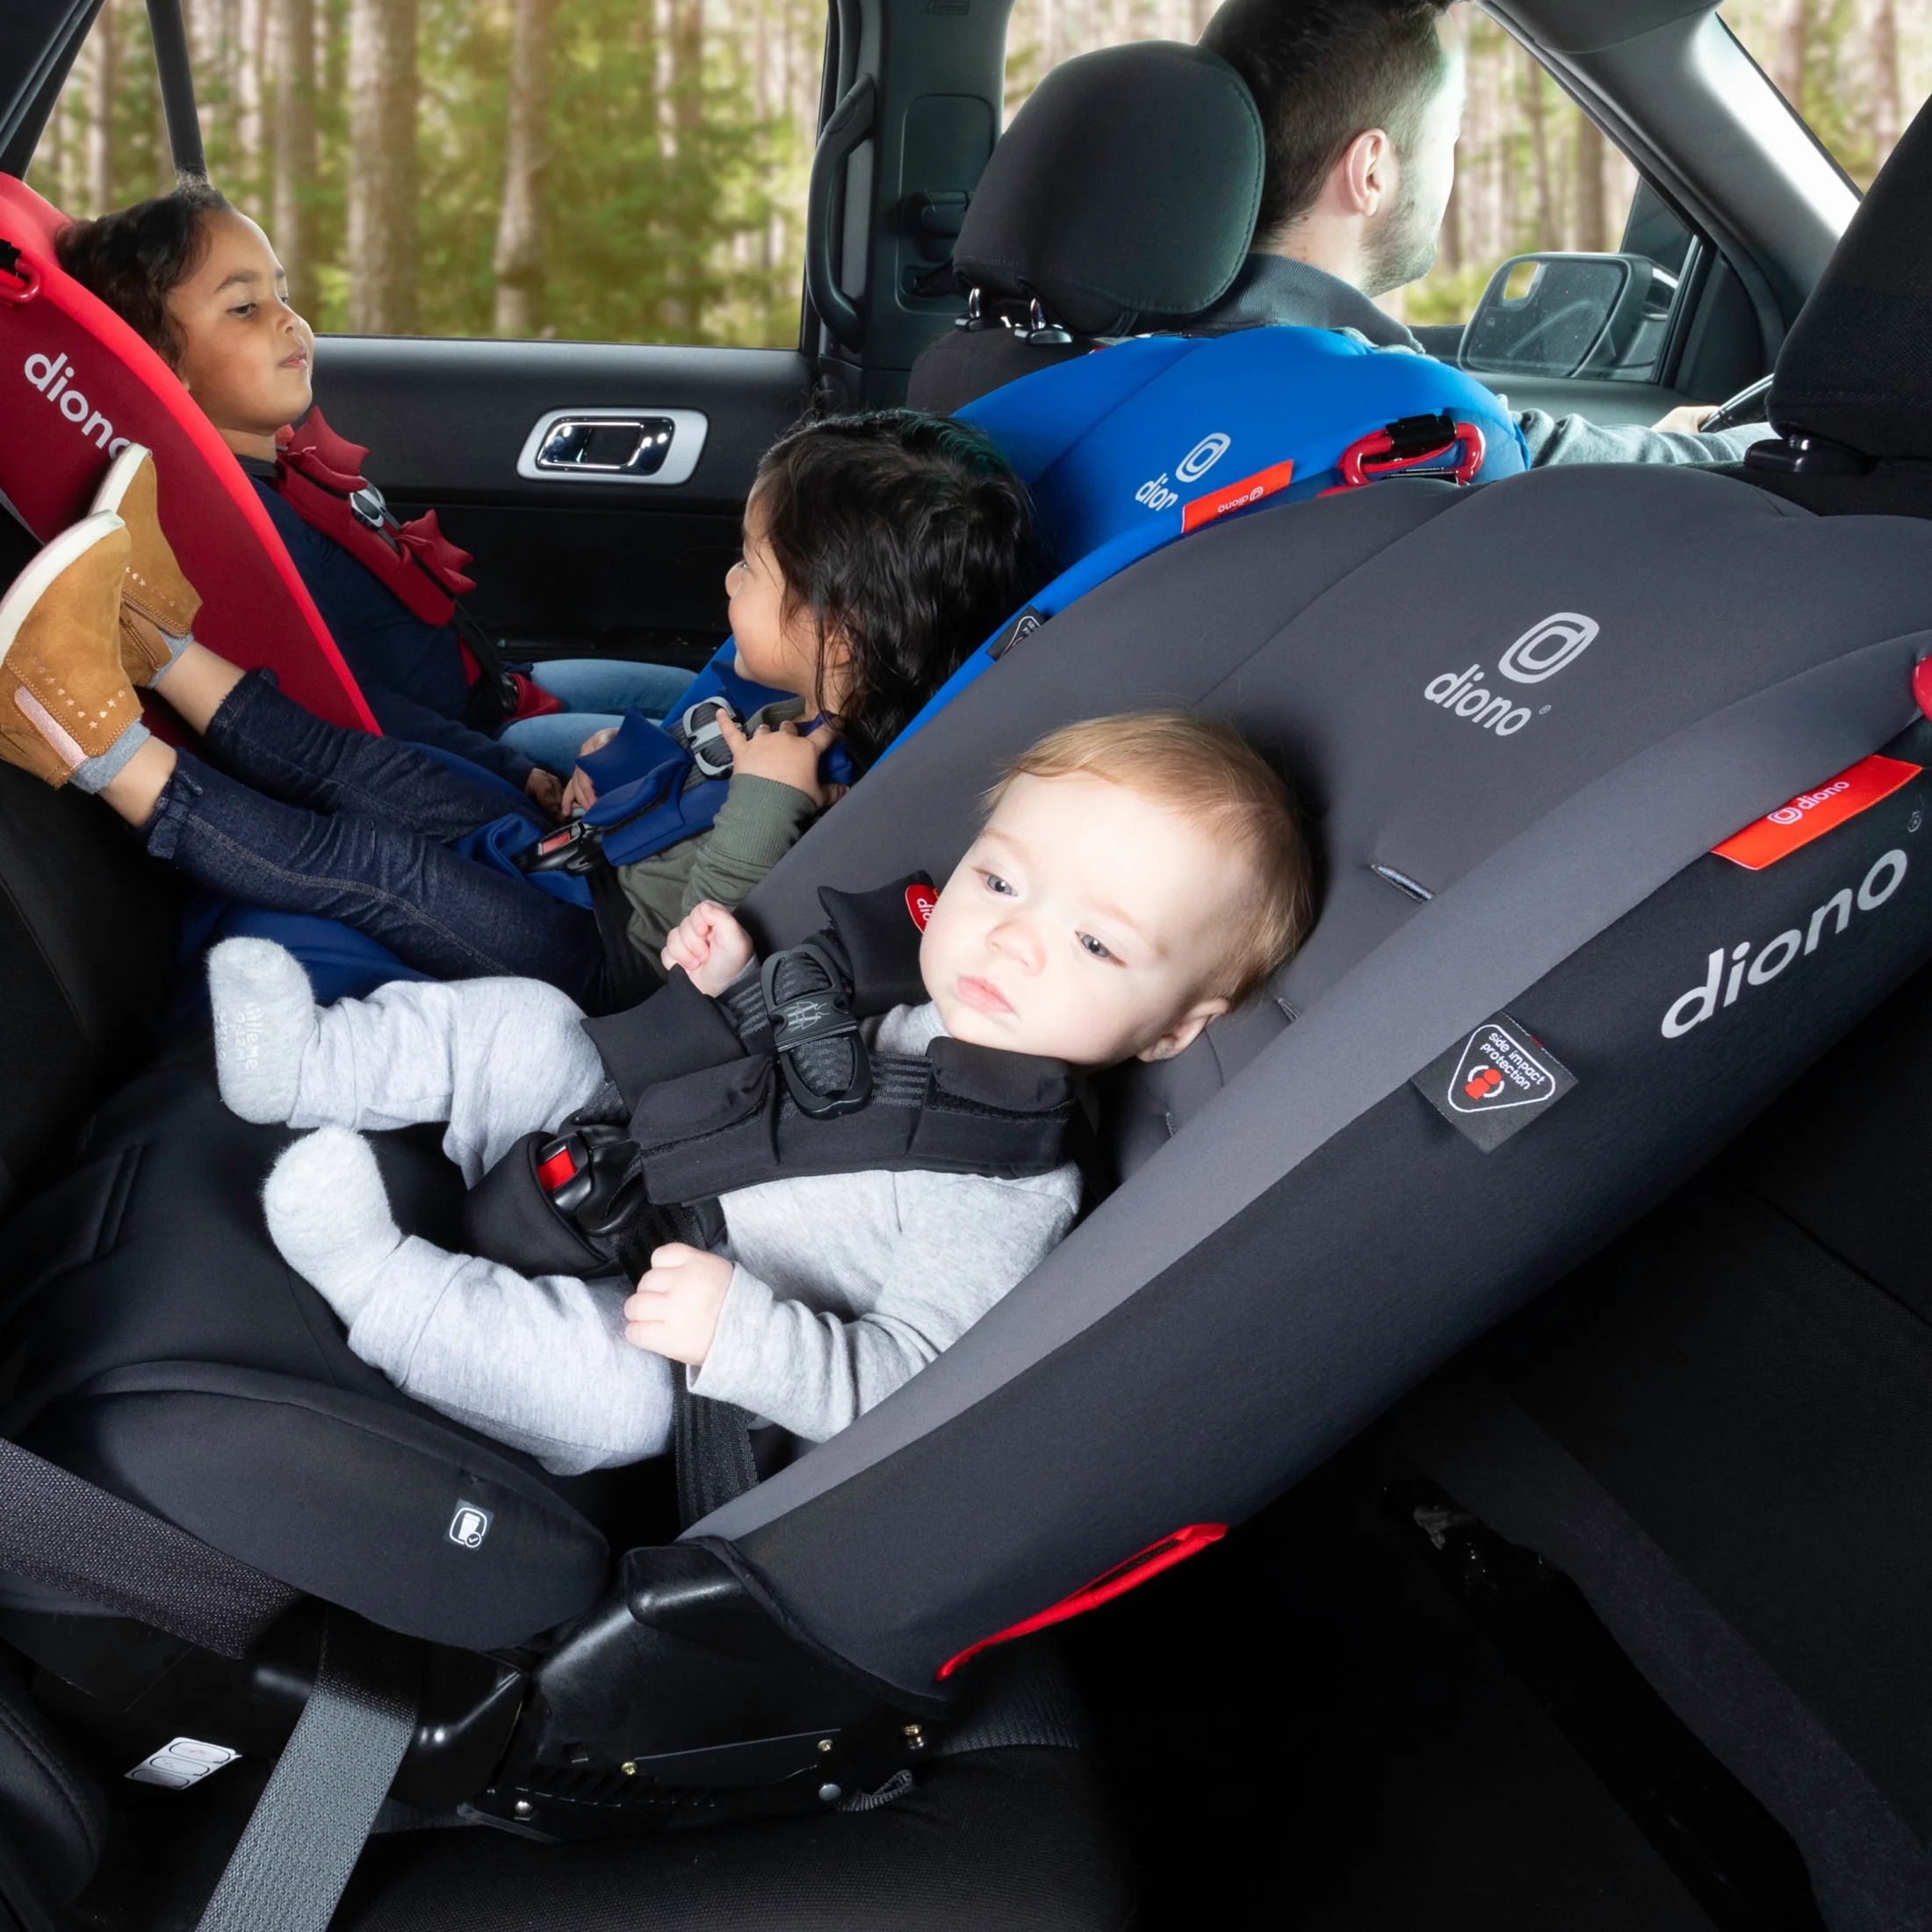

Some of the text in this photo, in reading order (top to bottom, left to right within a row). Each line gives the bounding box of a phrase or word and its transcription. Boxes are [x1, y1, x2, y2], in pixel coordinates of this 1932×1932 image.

[1217, 494, 1249, 513] diono
[1424, 663, 1532, 736] diono
[1798, 781, 1849, 810] diono
[1661, 848, 1907, 1039] diono
[1480, 1042, 1532, 1091] protection
[1489, 1032, 1546, 1085] side impact
